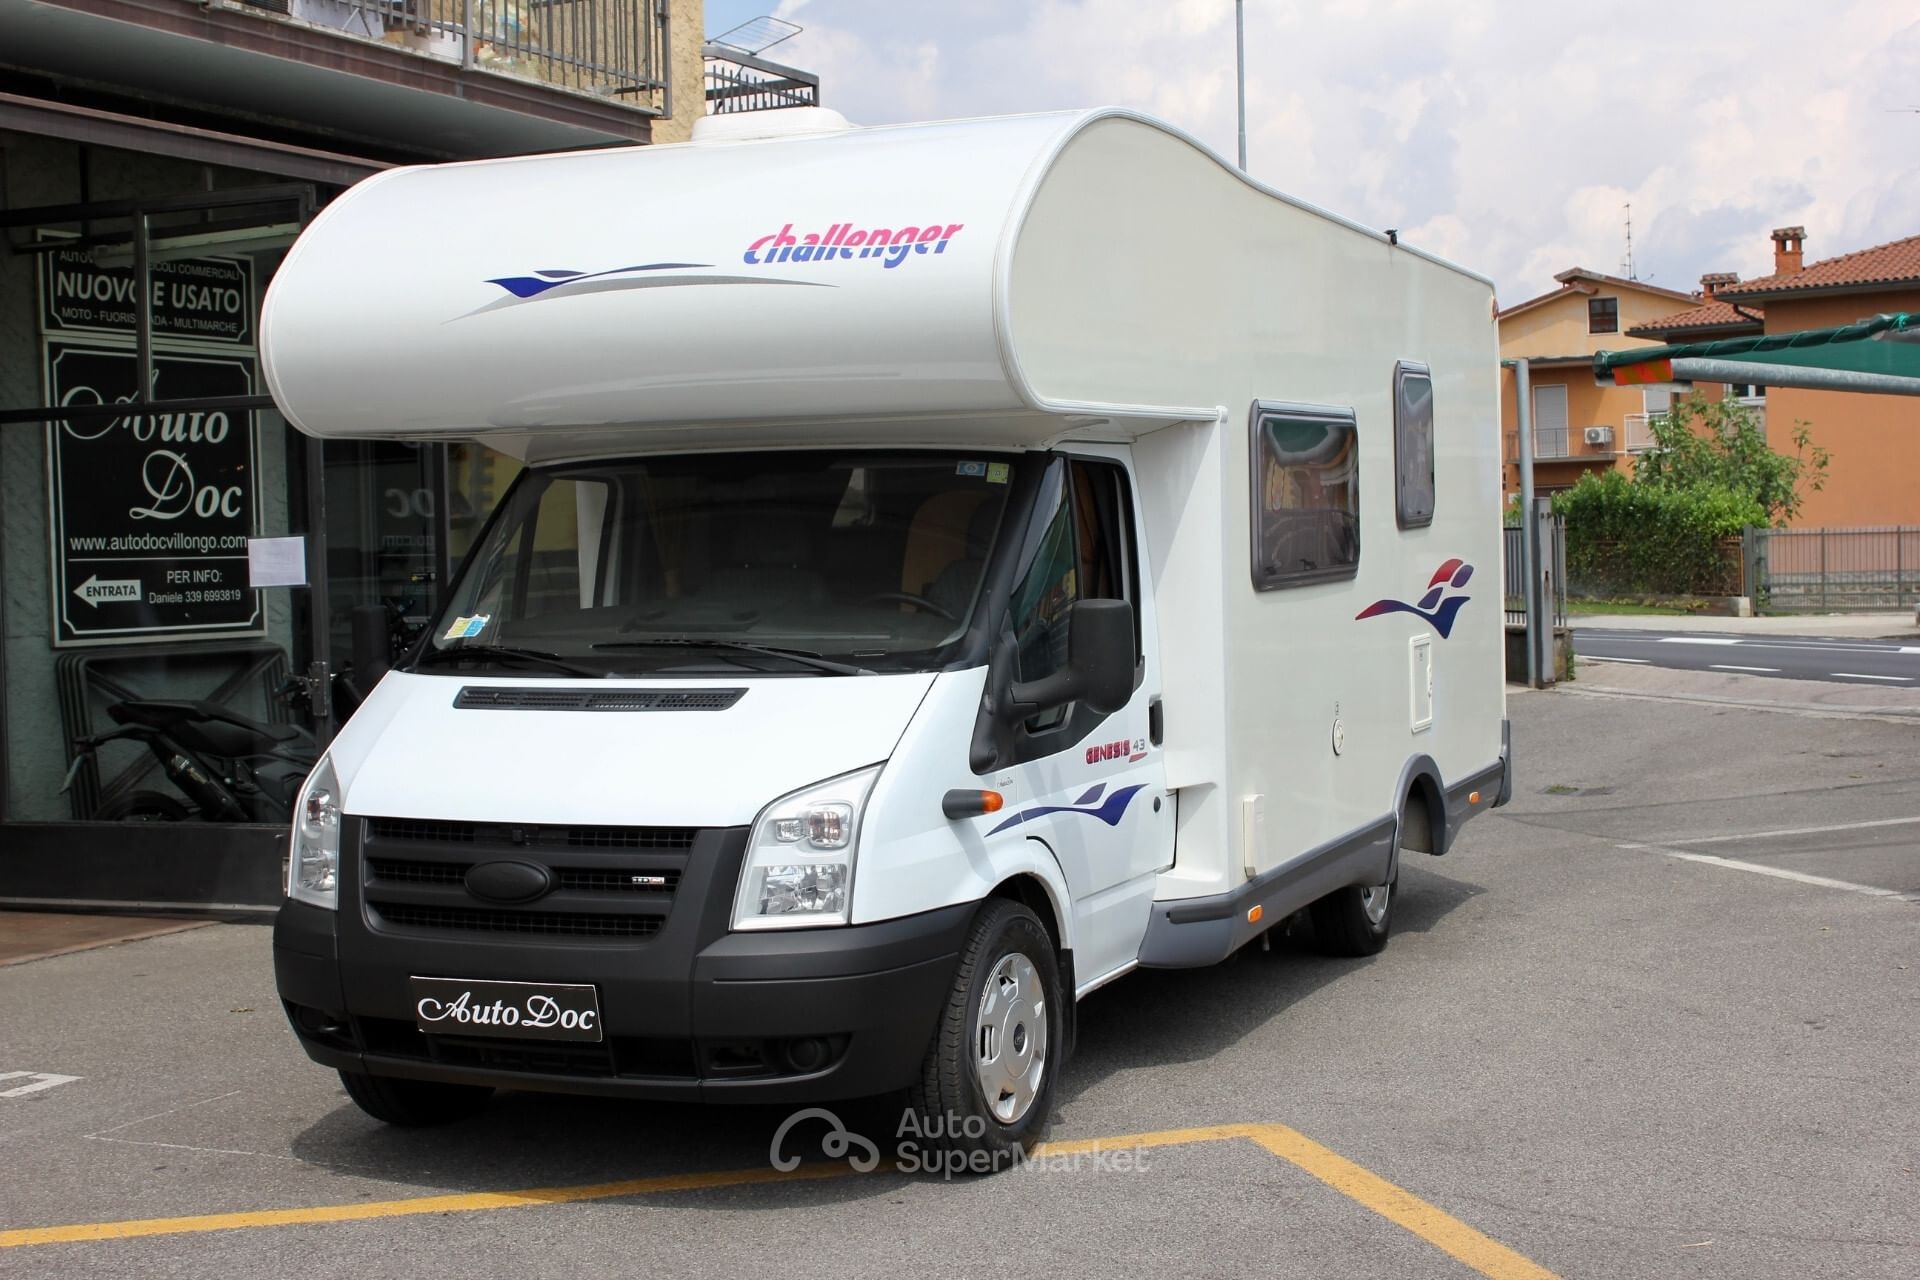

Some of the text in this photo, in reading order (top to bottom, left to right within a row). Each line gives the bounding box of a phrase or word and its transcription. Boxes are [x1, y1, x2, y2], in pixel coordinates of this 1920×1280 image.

[178, 263, 240, 281] COMMERCIALI
[153, 281, 165, 305] E
[172, 283, 240, 314] USATO
[61, 307, 92, 320] MOTO
[100, 310, 168, 327] FUORISDA
[174, 318, 238, 333] MULTIMARCHE
[129, 450, 243, 519] Doc
[69, 532, 248, 553] www.autodocvillongo.com
[167, 569, 223, 584] PER INFO:
[86, 580, 137, 597] ENTRATA
[149, 589, 241, 604] Daniele 339 6993819
[1133, 738, 1145, 751] 43
[417, 991, 596, 1030] Auto Doc
